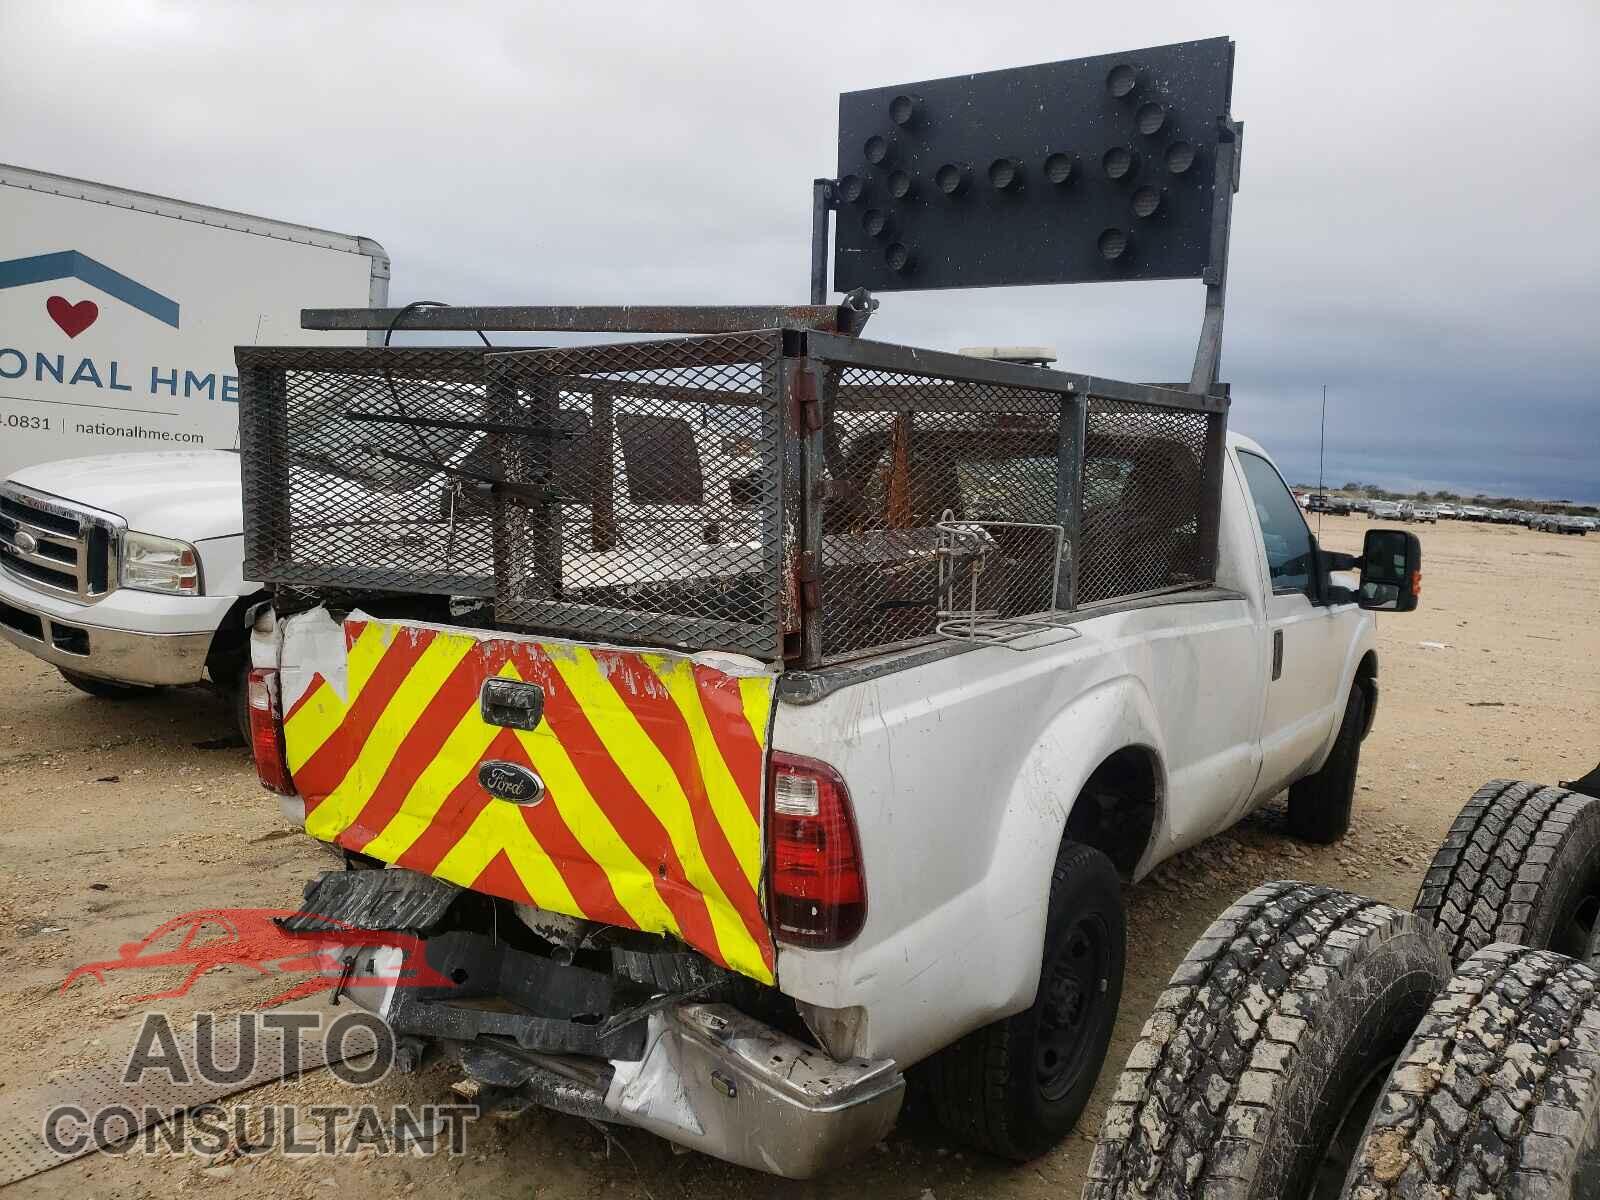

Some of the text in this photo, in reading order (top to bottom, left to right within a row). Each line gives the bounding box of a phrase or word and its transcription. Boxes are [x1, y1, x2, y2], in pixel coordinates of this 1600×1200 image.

[0, 348, 240, 402] ONAL HME
[76, 422, 204, 444] nationalhme.com
[487, 767, 526, 795] Ford
